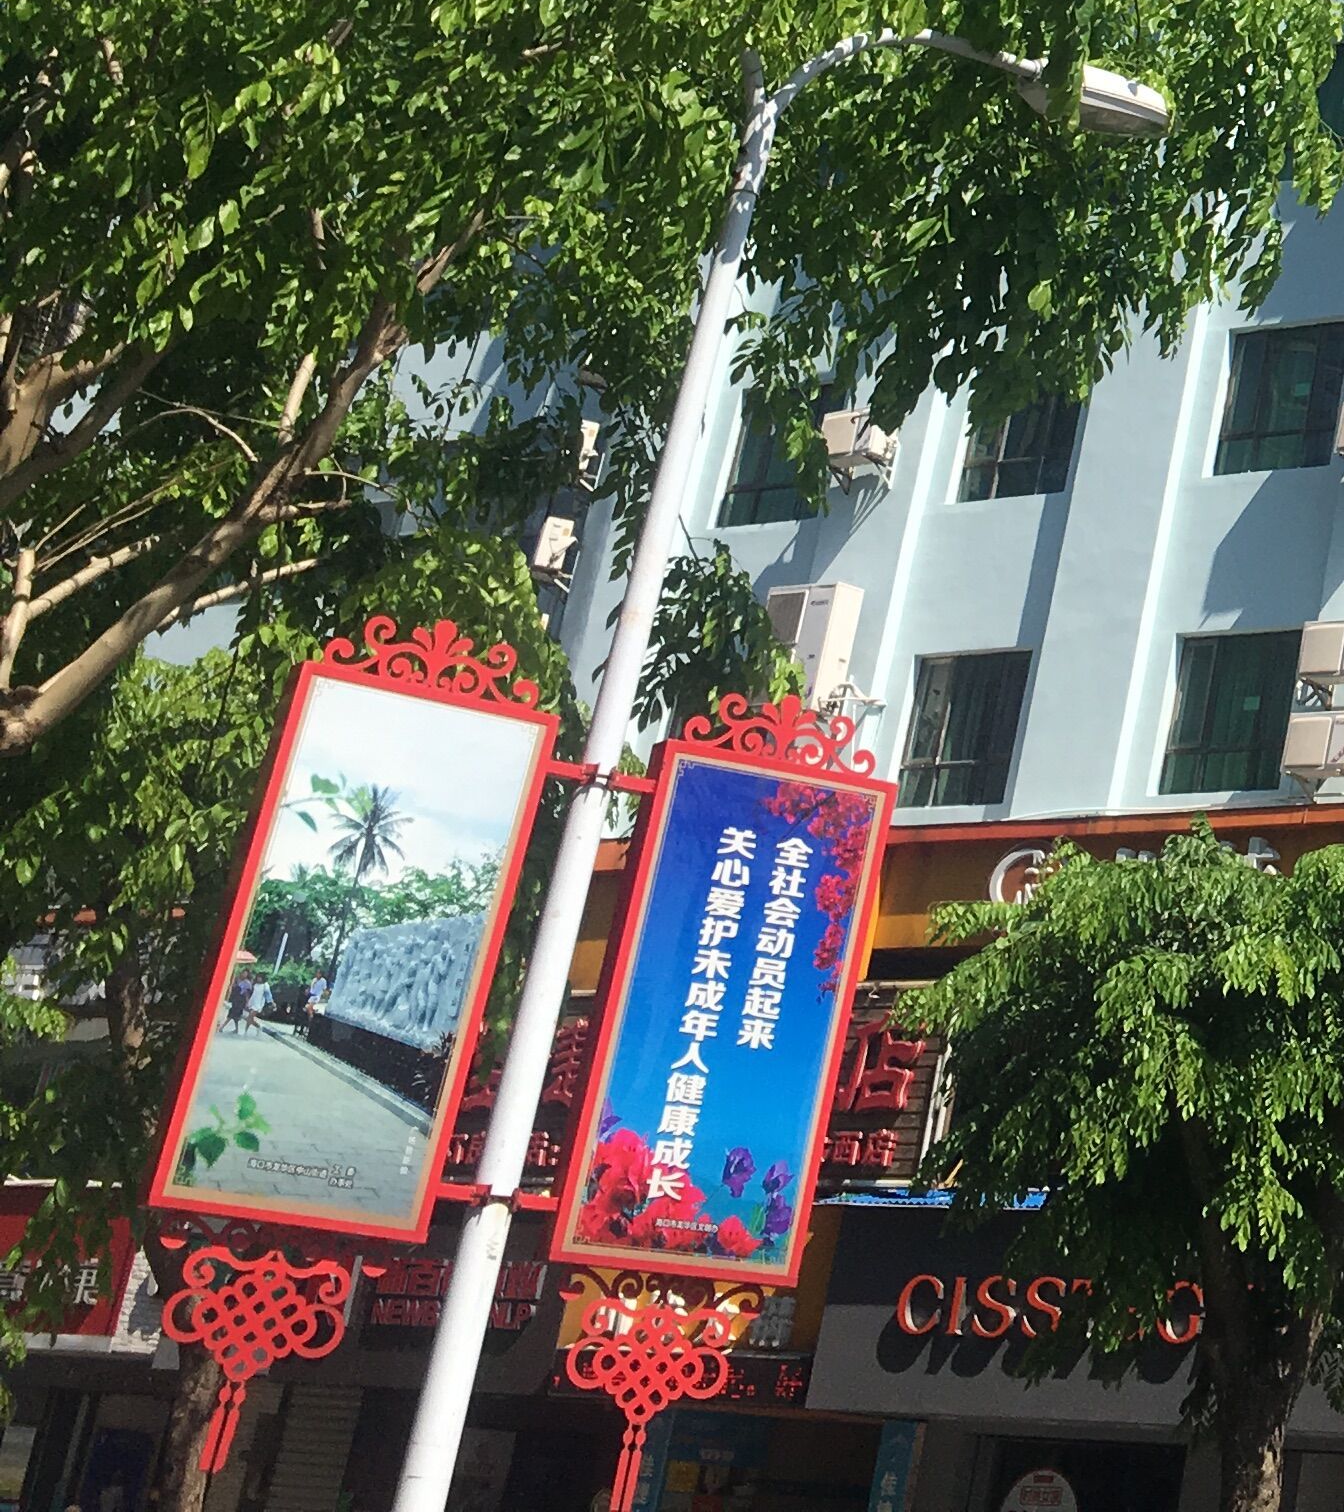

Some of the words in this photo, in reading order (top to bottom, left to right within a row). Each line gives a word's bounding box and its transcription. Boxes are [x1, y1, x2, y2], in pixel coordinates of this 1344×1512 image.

[646, 826, 757, 1201] 关心爱护未成年人健康成长
[737, 837, 814, 1050] 全社会动员起来
